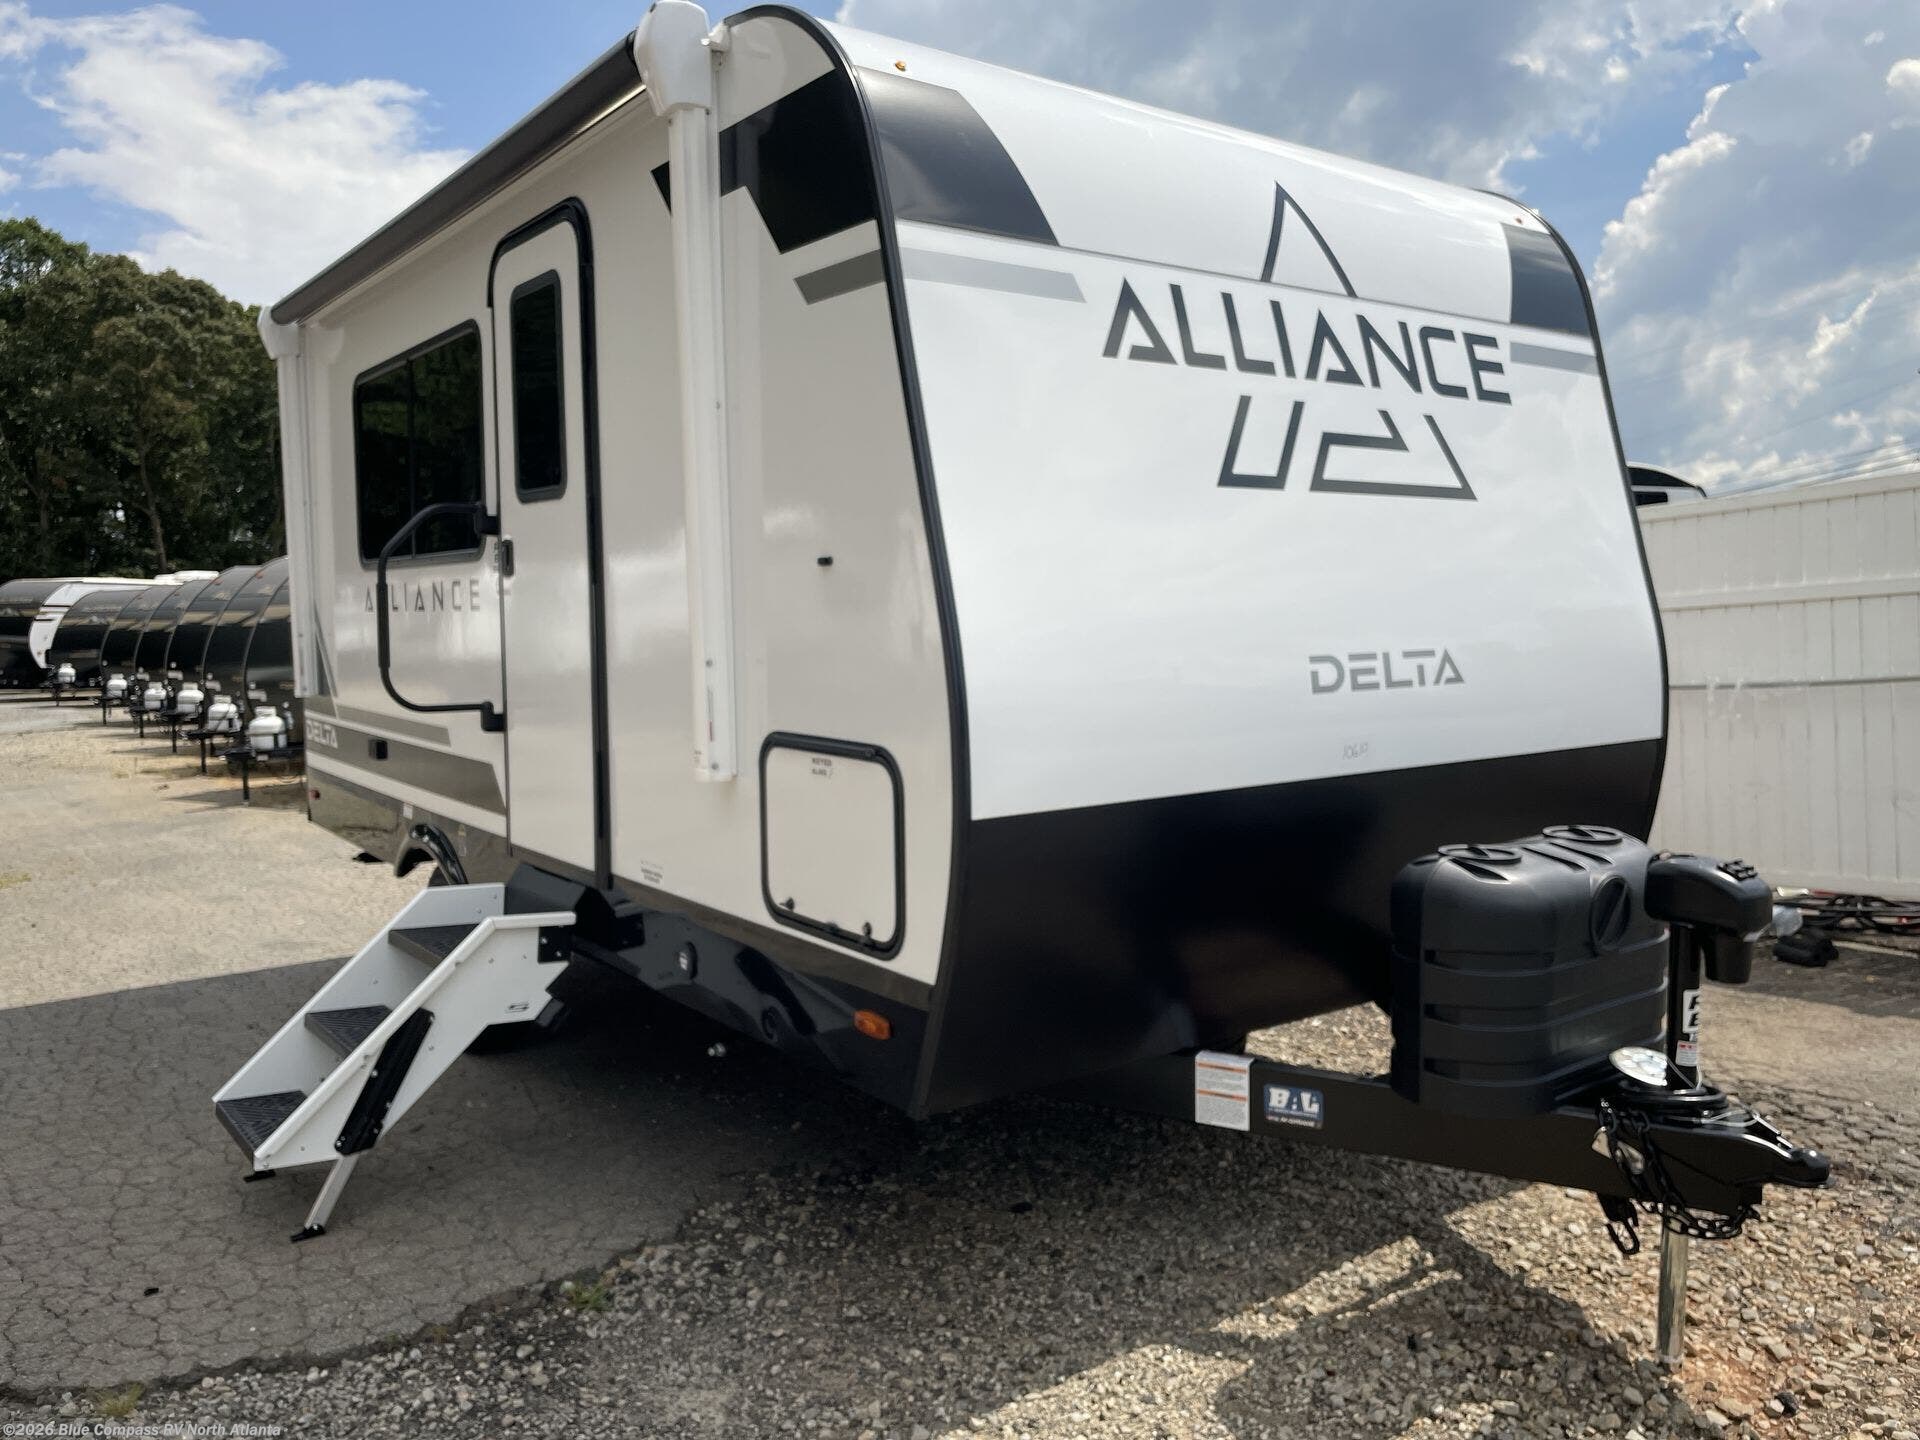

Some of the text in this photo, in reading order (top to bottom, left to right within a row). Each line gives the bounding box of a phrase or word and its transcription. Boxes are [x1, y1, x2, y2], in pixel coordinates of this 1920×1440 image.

[1102, 276, 1513, 405] ALLIANCE
[364, 578, 481, 613] ALIANCE
[1309, 648, 1466, 695] DELTA
[305, 719, 339, 750] DELTA
